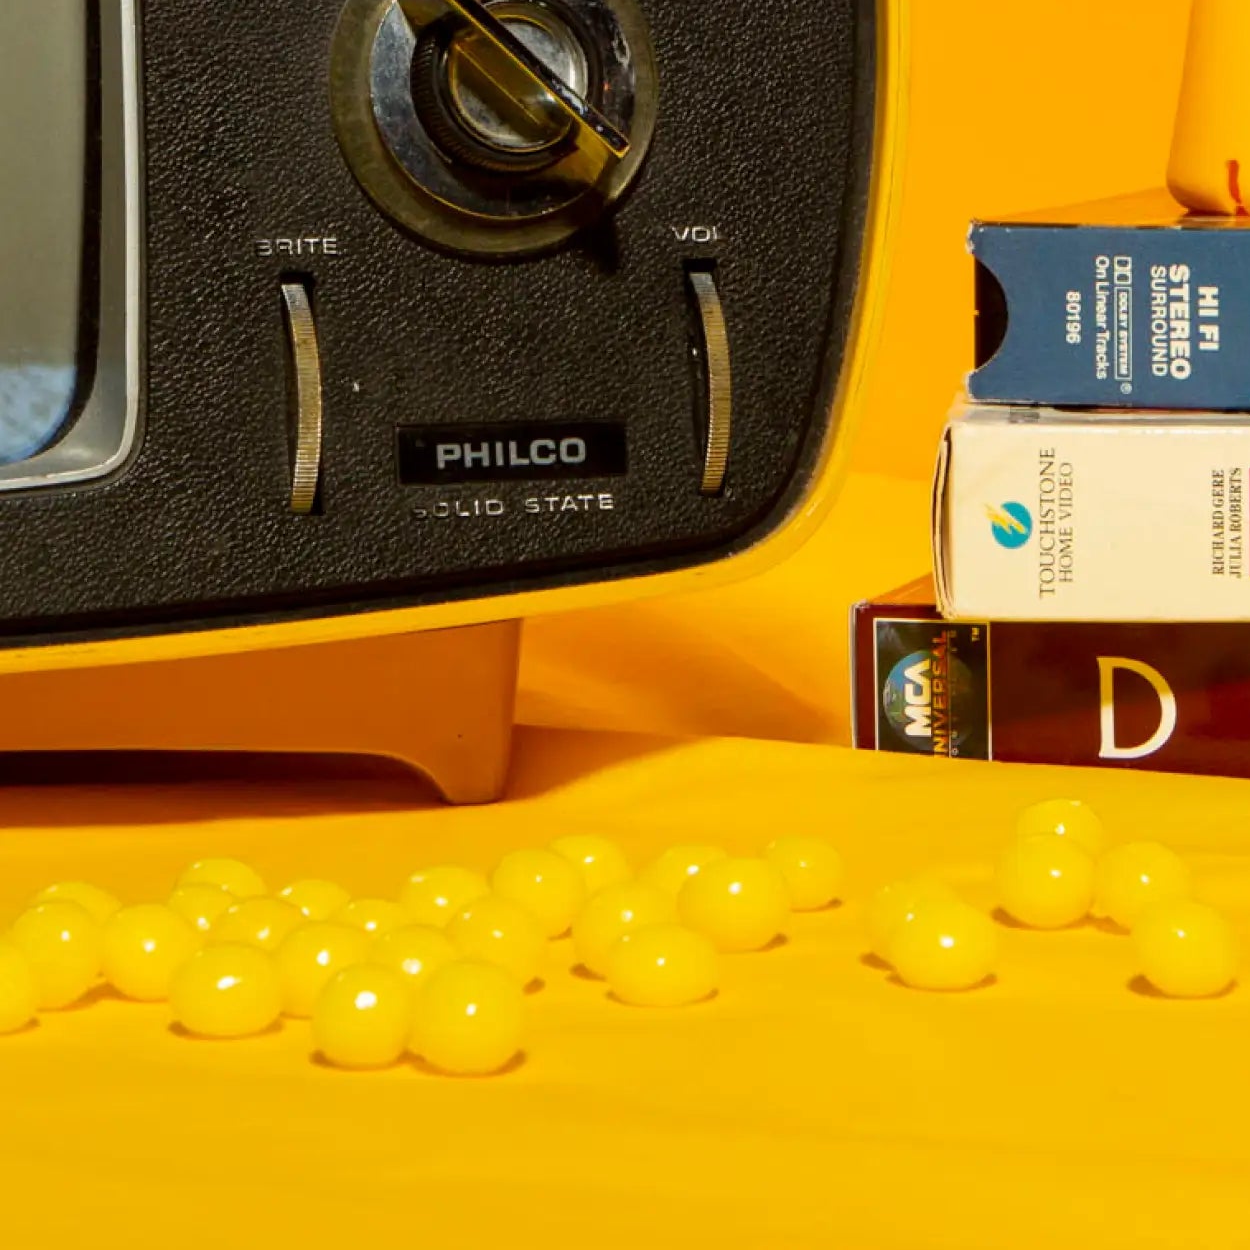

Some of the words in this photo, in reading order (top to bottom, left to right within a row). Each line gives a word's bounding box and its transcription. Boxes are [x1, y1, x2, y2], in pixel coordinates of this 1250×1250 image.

[1095, 255, 1110, 279] On
[1065, 290, 1082, 344] 80196
[1095, 281, 1110, 328] Linear
[1151, 265, 1168, 377] SURROUND
[1169, 264, 1191, 380] STEREO
[1198, 286, 1219, 317] HI
[1095, 330, 1111, 380] Tracks
[1198, 324, 1220, 351] FI
[436, 437, 586, 470] PHILCO
[524, 493, 614, 514] STATE
[1058, 461, 1074, 522] VIDEO
[1211, 469, 1225, 507] GERE
[1228, 467, 1242, 533] ROBERTS
[1039, 447, 1056, 599] TOUCHSTONE
[1211, 509, 1225, 576] RICHARD
[1058, 526, 1074, 583] HOME
[1228, 535, 1242, 579] JULIA
[904, 658, 931, 736] MCA
